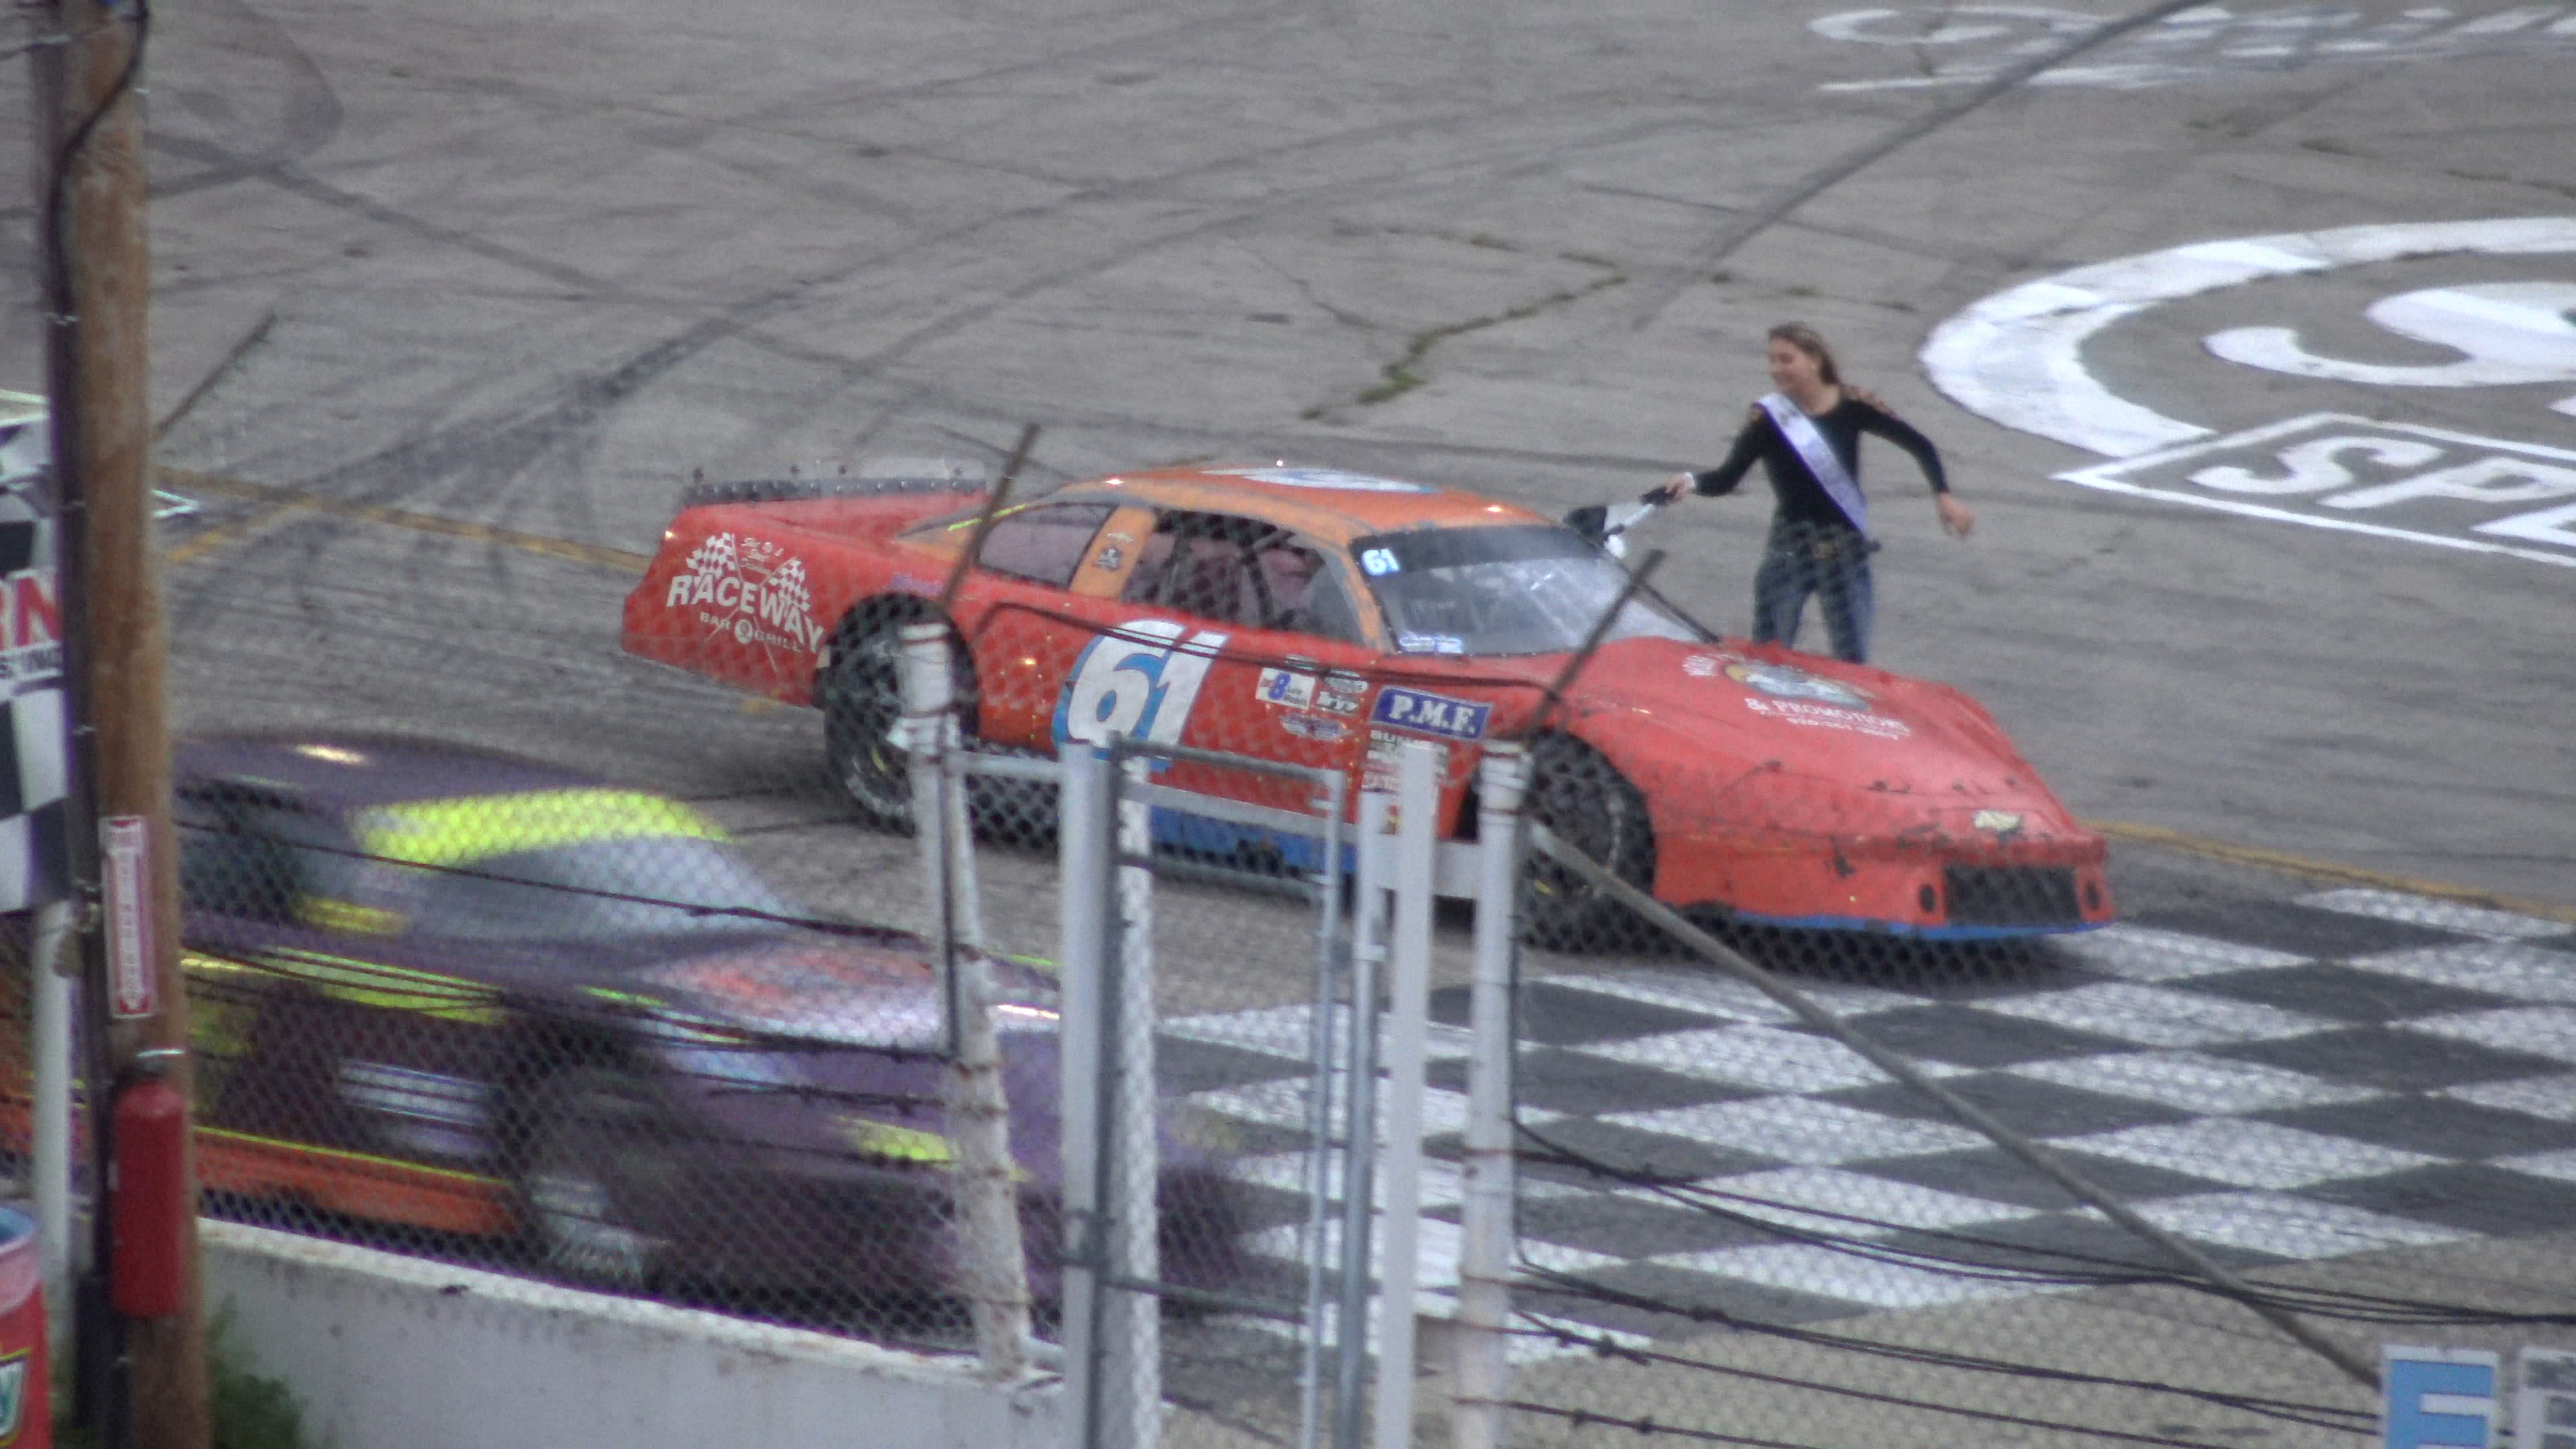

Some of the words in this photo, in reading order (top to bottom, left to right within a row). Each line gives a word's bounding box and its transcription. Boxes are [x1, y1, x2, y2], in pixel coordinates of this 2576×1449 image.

[1362, 548, 1399, 576] 61
[666, 574, 826, 654] RACEWAY
[700, 611, 732, 631] BAR
[754, 629, 802, 653] GRILL
[1061, 618, 1230, 751] 61
[1389, 694, 1475, 734] P.M.F.
